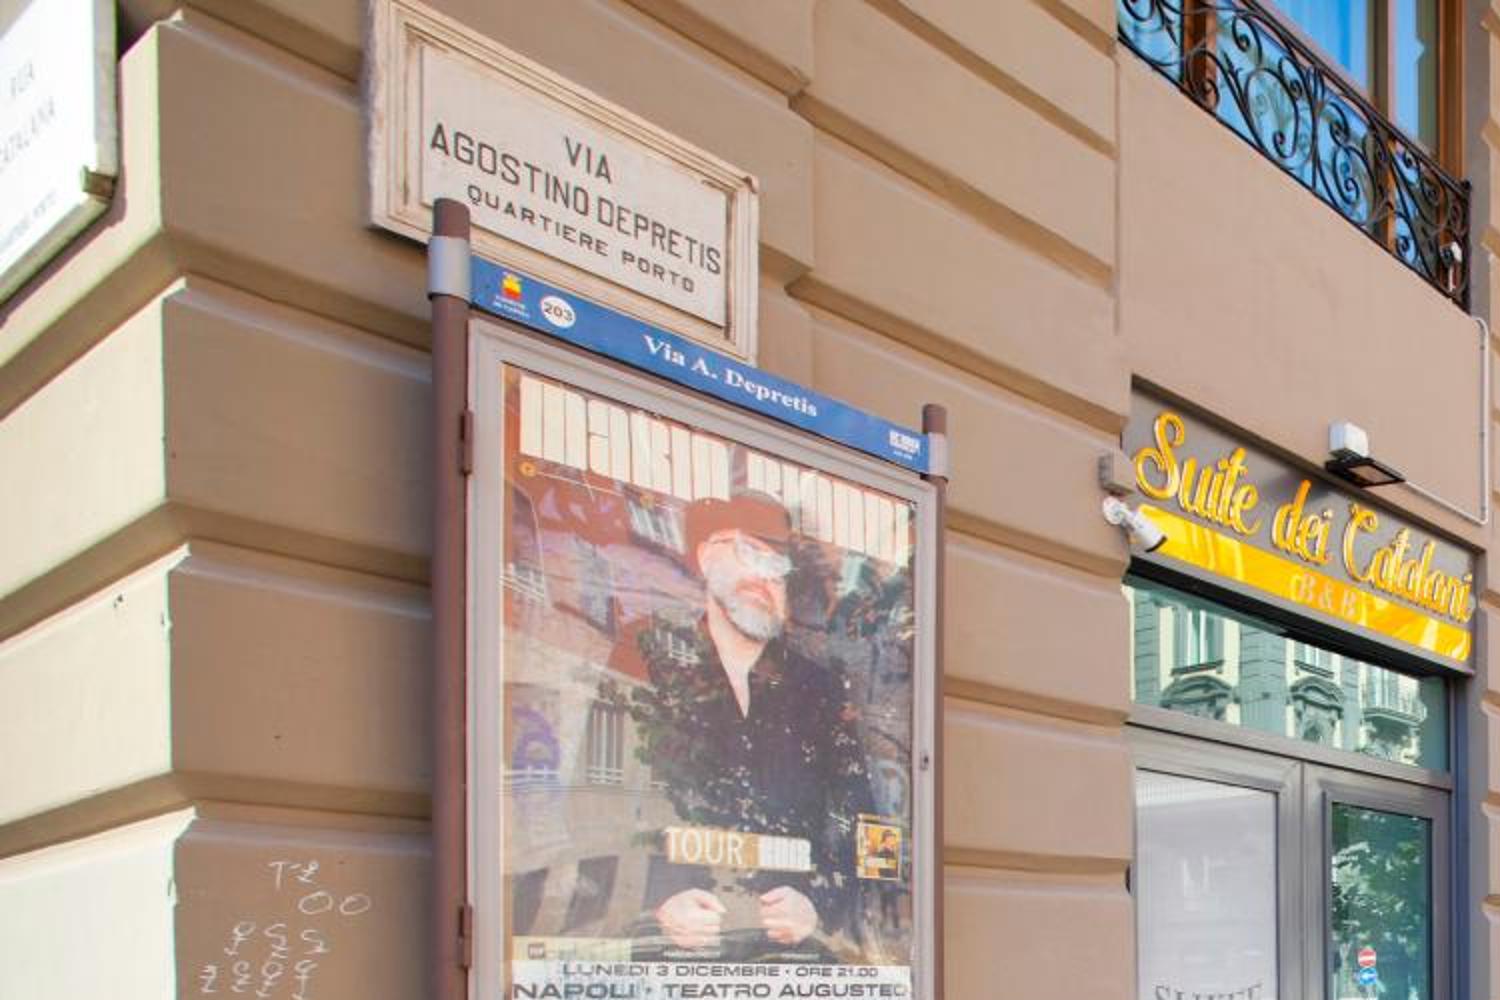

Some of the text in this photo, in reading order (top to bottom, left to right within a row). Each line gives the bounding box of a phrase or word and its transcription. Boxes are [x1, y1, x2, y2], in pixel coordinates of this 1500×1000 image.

[564, 136, 612, 184] VIA
[430, 123, 721, 275] AGOSTINO DEPRETIS
[467, 184, 695, 293] QUARTIERE PORTO
[543, 302, 573, 322] 203
[643, 334, 818, 418] Via A. Depretis
[1133, 410, 1473, 623] Suite dei Catalani
[665, 827, 743, 866] TOUR
[513, 982, 906, 999] NAPOLI TEATRO AUGUSTEO
[656, 965, 669, 977] 3
[675, 965, 780, 977] DICEMBRE
[795, 966, 832, 977] ORE
[836, 966, 879, 977] 21.00
